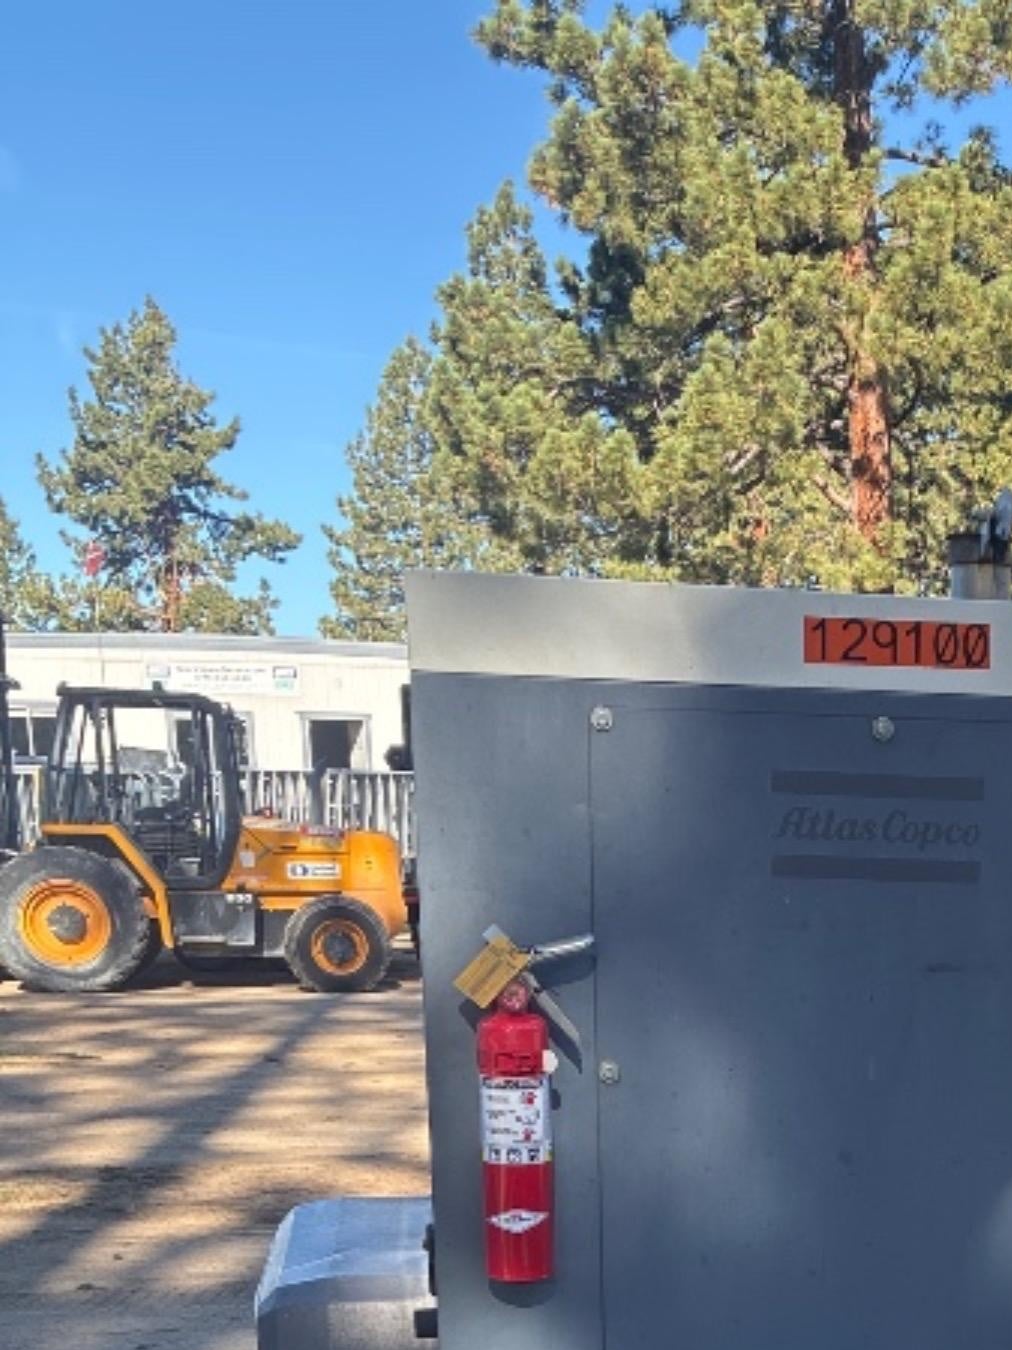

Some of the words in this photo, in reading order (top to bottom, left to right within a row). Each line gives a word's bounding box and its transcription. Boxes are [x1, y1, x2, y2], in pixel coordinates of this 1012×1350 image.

[811, 617, 990, 668] 129100
[773, 805, 880, 841] Atlas
[882, 808, 980, 851] Copco
